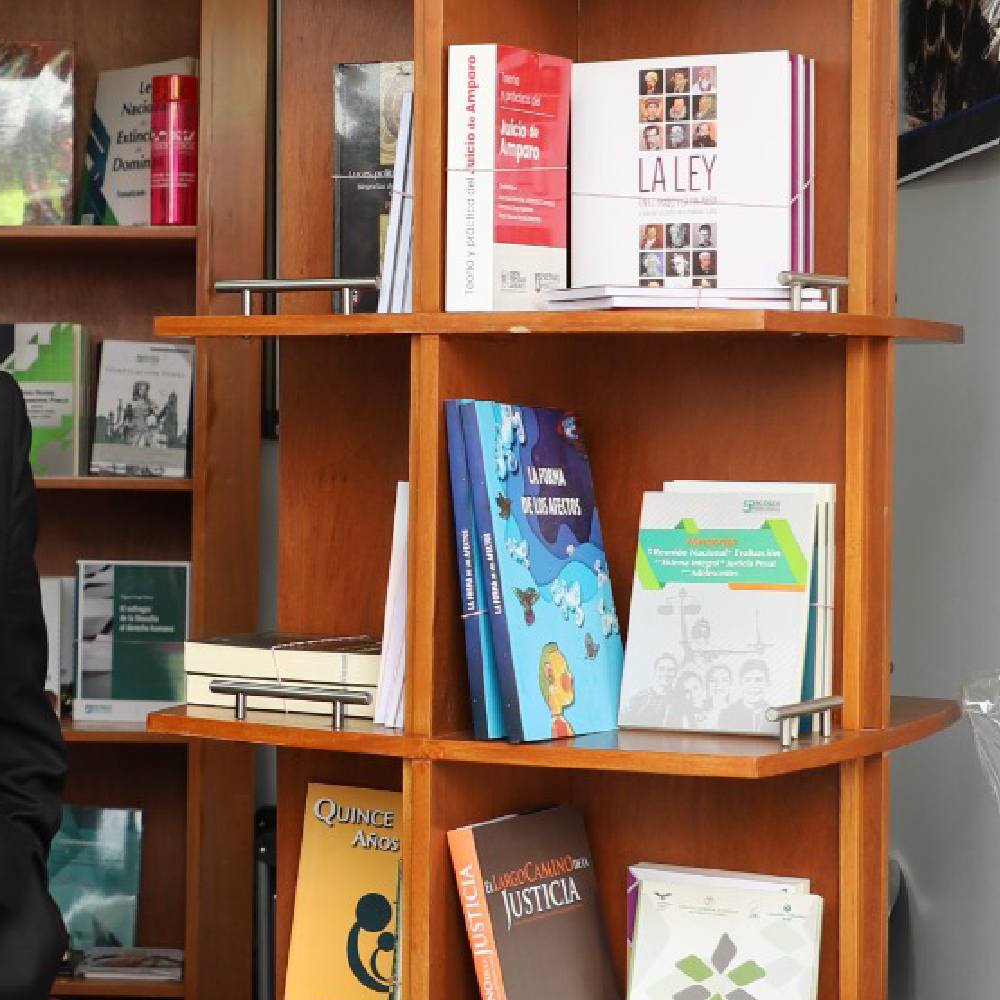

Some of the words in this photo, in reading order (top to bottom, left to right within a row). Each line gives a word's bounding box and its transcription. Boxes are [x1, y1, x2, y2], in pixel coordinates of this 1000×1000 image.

[139, 81, 151, 95] Le
[465, 54, 479, 114] Amparo
[501, 118, 526, 139] Juicio
[113, 154, 151, 171] Domin
[501, 138, 540, 163] Amparo
[638, 156, 667, 193] LA
[675, 154, 718, 193] LEY
[527, 465, 539, 485] LA
[539, 466, 567, 487] FORMA
[521, 496, 533, 514] DE
[533, 496, 549, 515] LOS
[548, 497, 583, 516] AFECTOS
[313, 798, 395, 828] QUINCE
[352, 829, 400, 852] AÑOS
[525, 855, 574, 883] CAMINO
[460, 863, 494, 956] JUSTICIA
[501, 876, 582, 931] JUSTICIA
